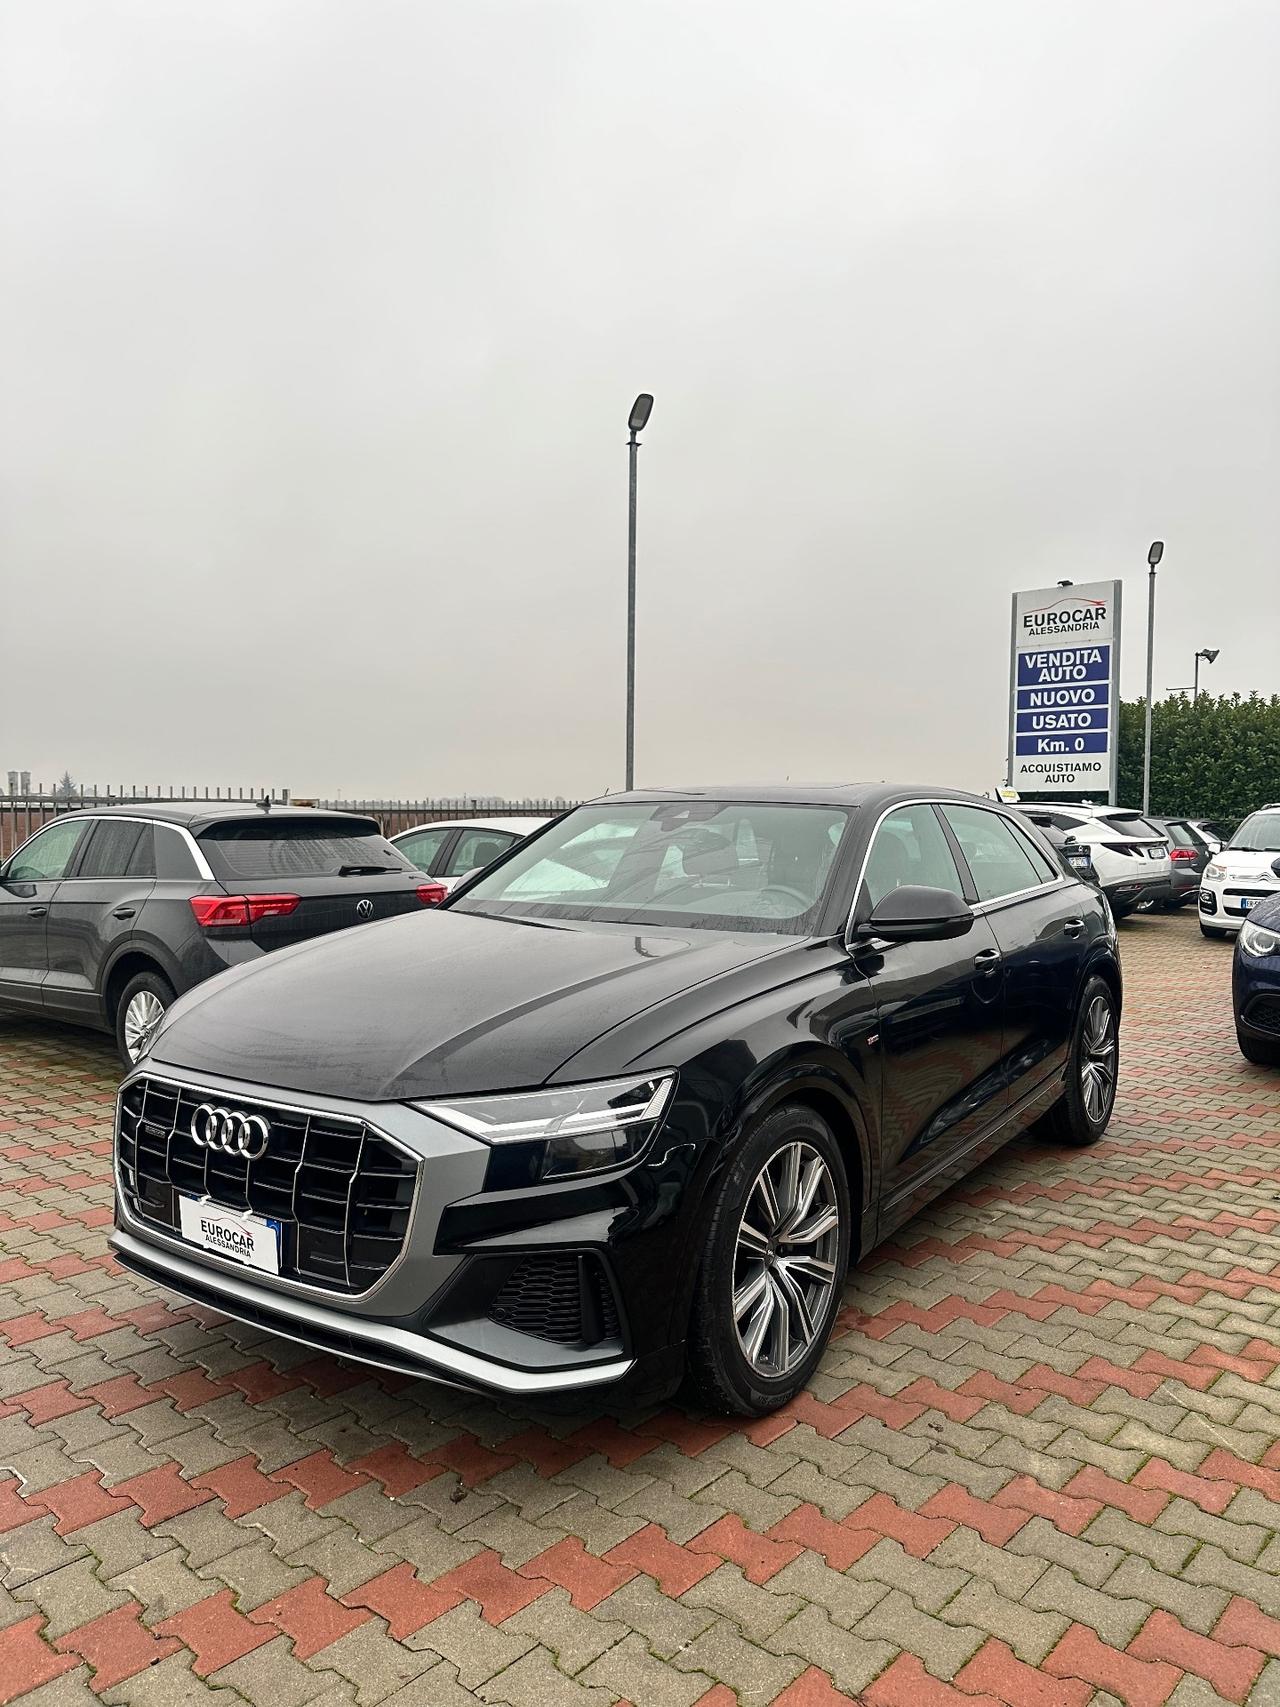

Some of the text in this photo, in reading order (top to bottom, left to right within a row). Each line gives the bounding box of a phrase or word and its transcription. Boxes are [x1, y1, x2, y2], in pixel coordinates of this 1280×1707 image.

[1023, 607, 1106, 628] EUROCAR
[1028, 622, 1100, 636] ALESSANDRIA
[1025, 649, 1102, 668] VENDITA
[1038, 666, 1087, 682] AUTO
[1030, 688, 1095, 707] NUOVO
[1032, 712, 1092, 730] USATO
[1037, 737, 1085, 753] Km. 0
[1020, 762, 1102, 774] ACQUISTIAMO
[1044, 773, 1076, 784] AUTO
[200, 1219, 255, 1251] EUROCAR
[205, 1234, 252, 1258] ALESSANDRIA
